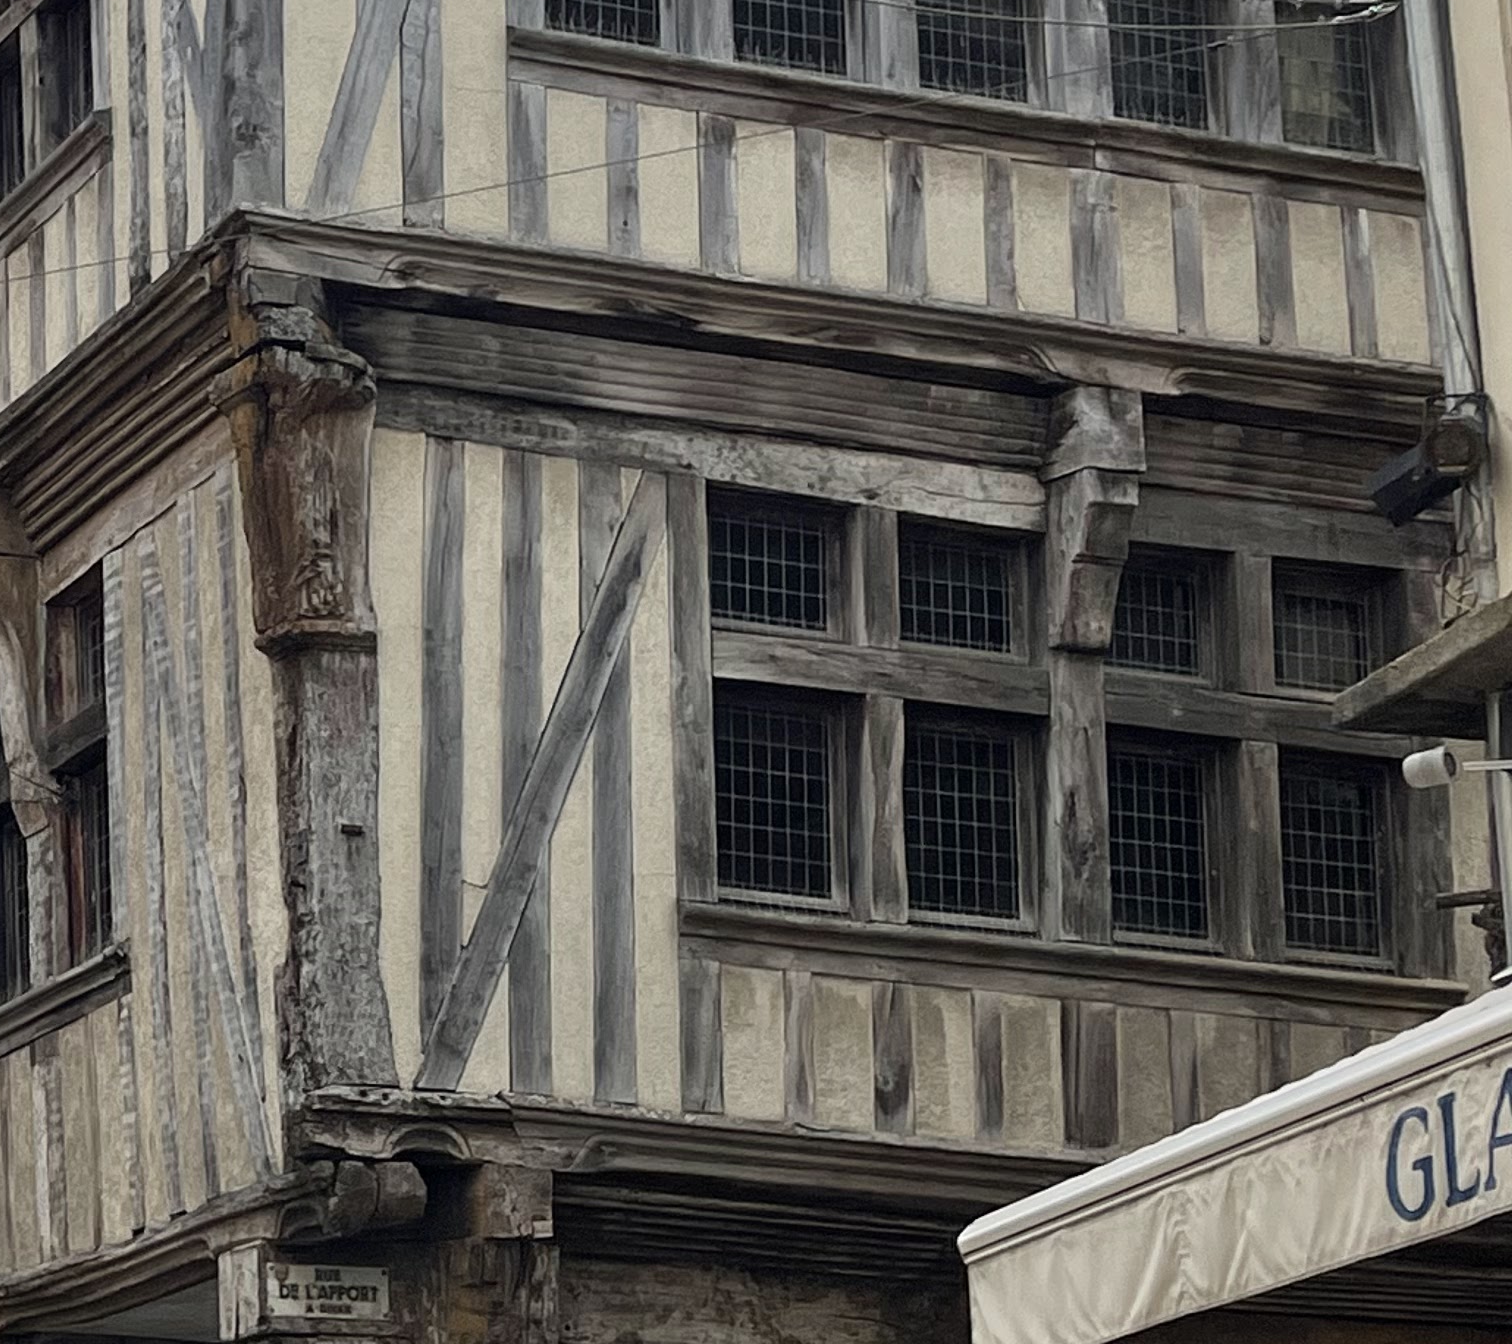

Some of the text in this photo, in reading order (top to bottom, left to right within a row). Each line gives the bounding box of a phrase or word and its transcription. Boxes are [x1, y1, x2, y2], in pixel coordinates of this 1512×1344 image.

[314, 1268, 341, 1282] RUE
[280, 1285, 377, 1303] DE L'APPORT
